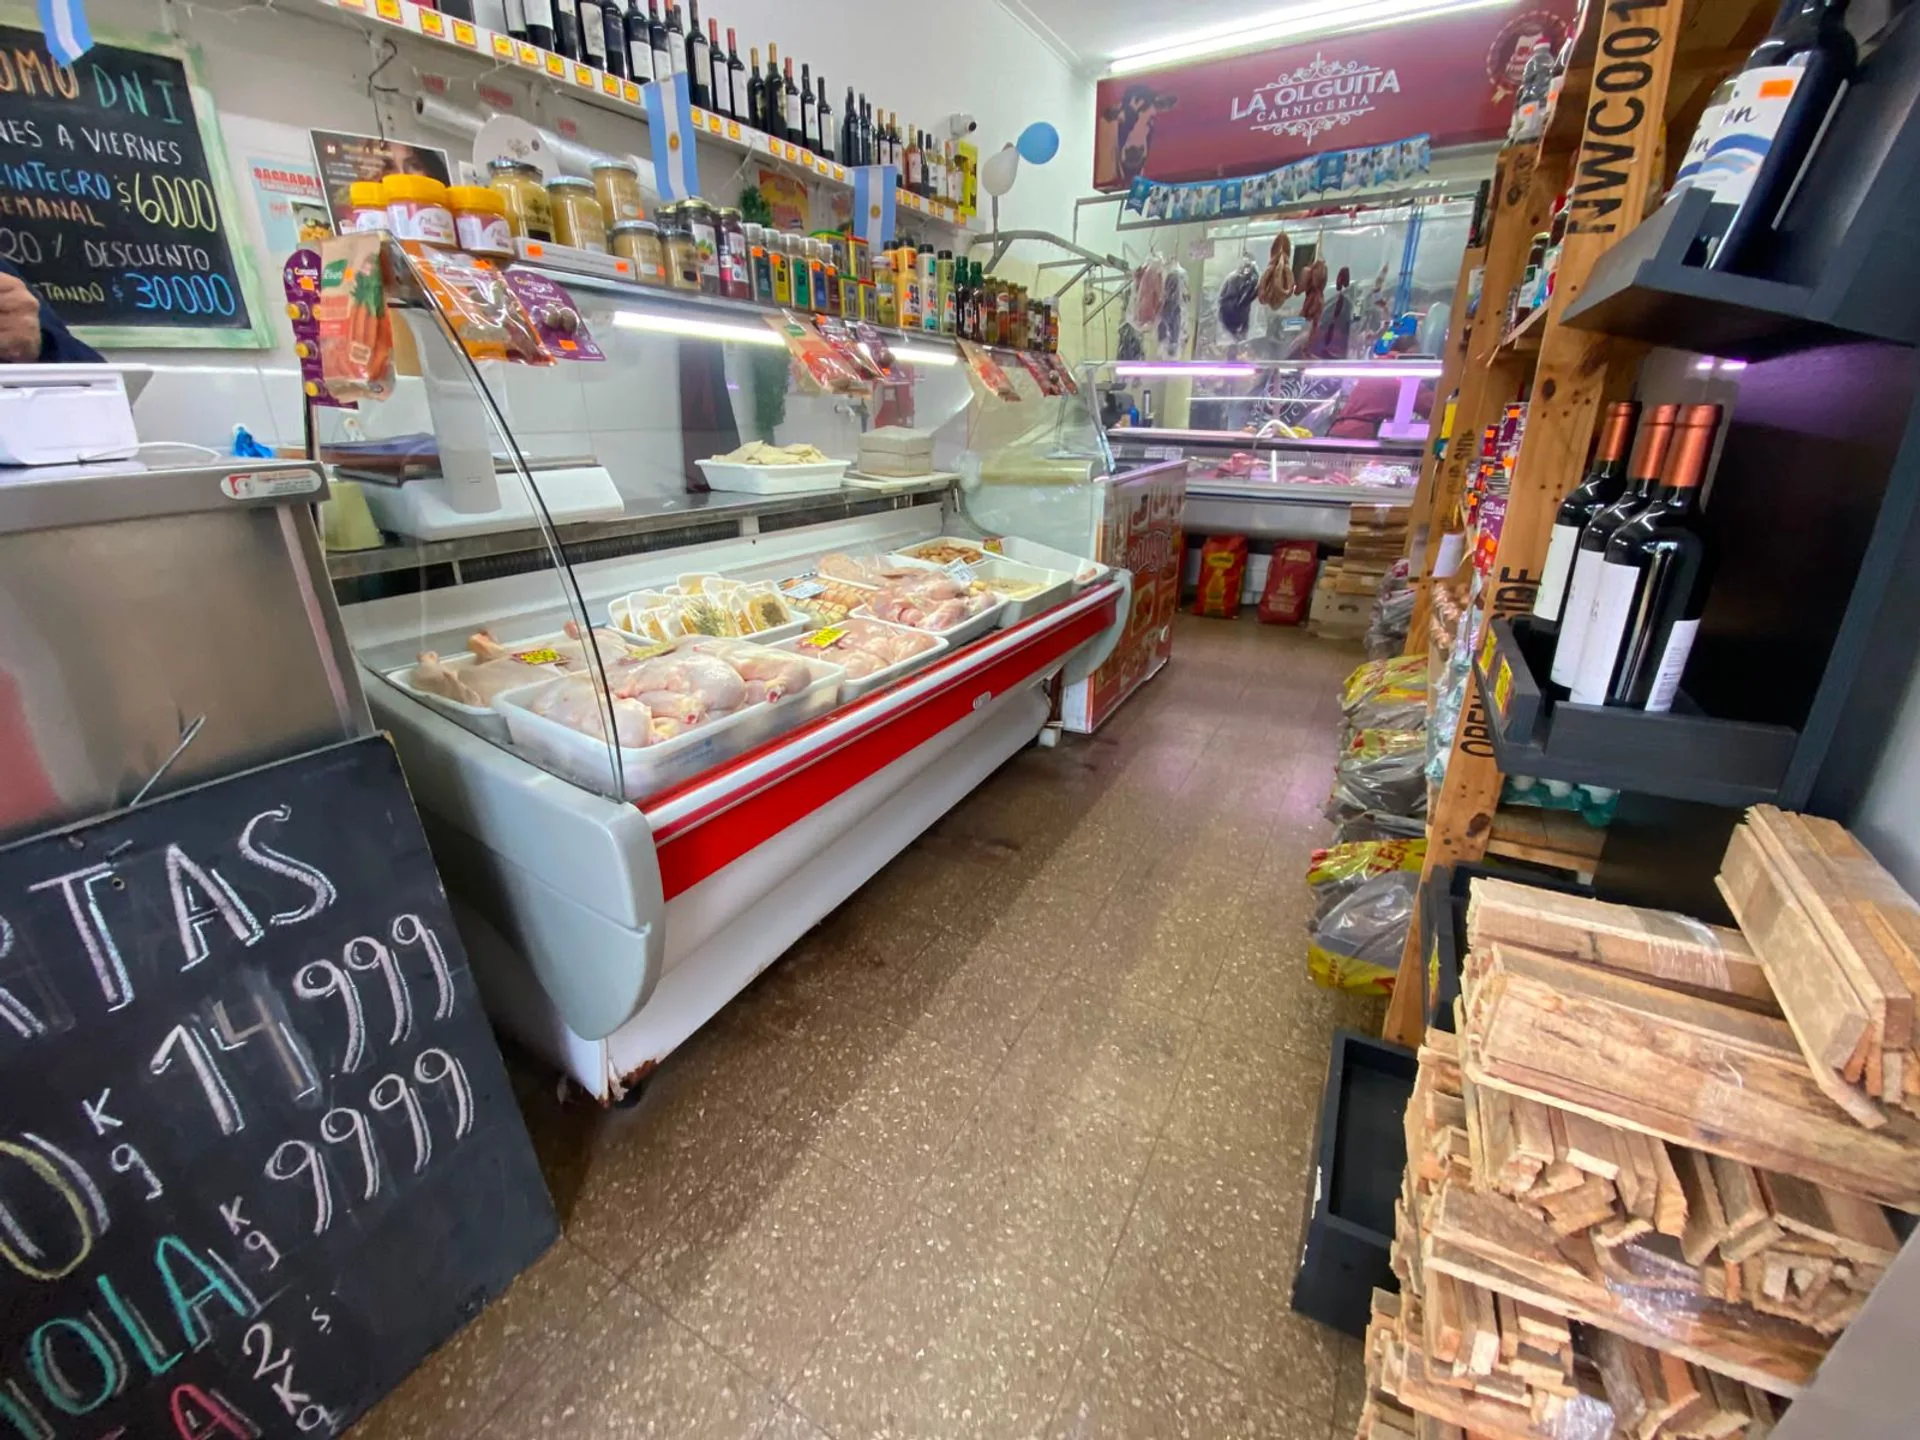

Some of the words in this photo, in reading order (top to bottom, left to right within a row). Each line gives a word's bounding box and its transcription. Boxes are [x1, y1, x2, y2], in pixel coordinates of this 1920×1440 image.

[91, 62, 184, 125] DNI
[1230, 93, 1267, 121] LA
[1274, 69, 1401, 107] OLGUITA
[1256, 94, 1370, 123] CARNICERIA
[57, 123, 75, 151] A
[80, 126, 183, 166] VIERNES
[0, 160, 112, 201] INTEGRO
[0, 227, 42, 264] 20
[84, 239, 211, 271] DESCUENTO
[32, 281, 105, 303] TANDO
[264, 1048, 474, 1237] 9999
